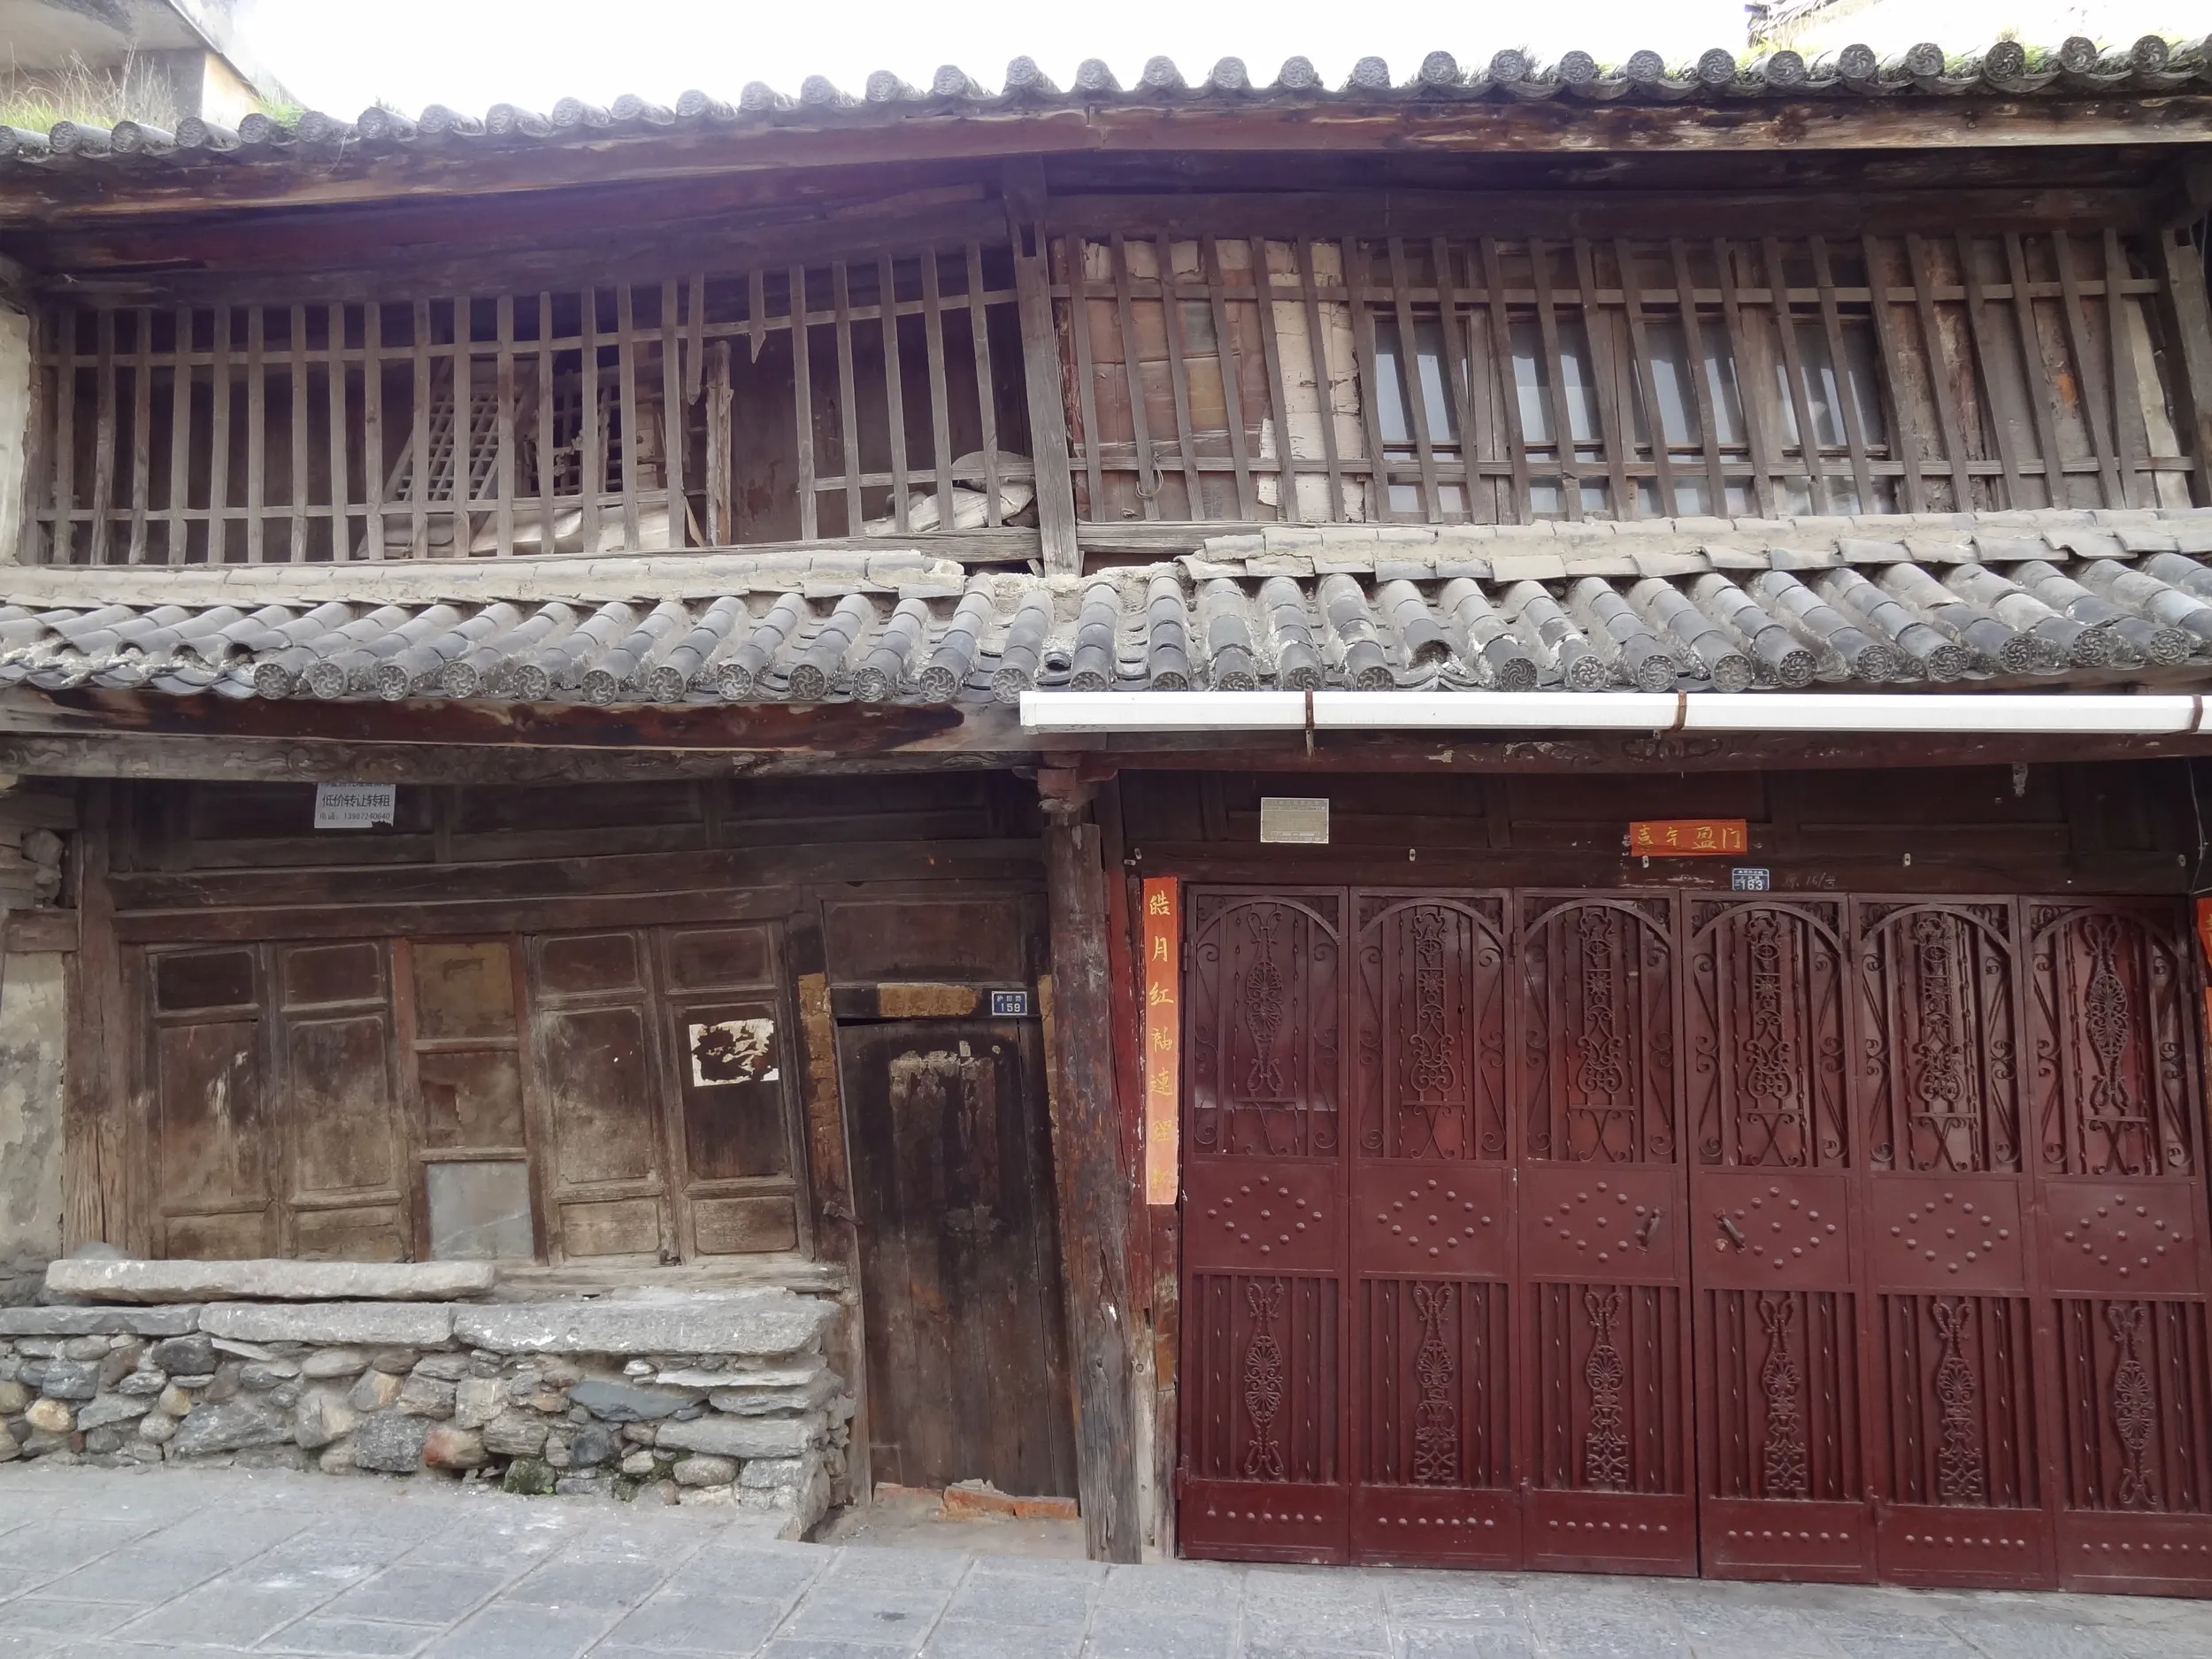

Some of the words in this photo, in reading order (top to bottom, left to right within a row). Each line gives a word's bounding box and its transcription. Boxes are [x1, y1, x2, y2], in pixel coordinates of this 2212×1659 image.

[322, 794, 390, 807] 低价转让转租
[1740, 879, 1763, 891] 163
[1001, 1002, 1020, 1012] 159
